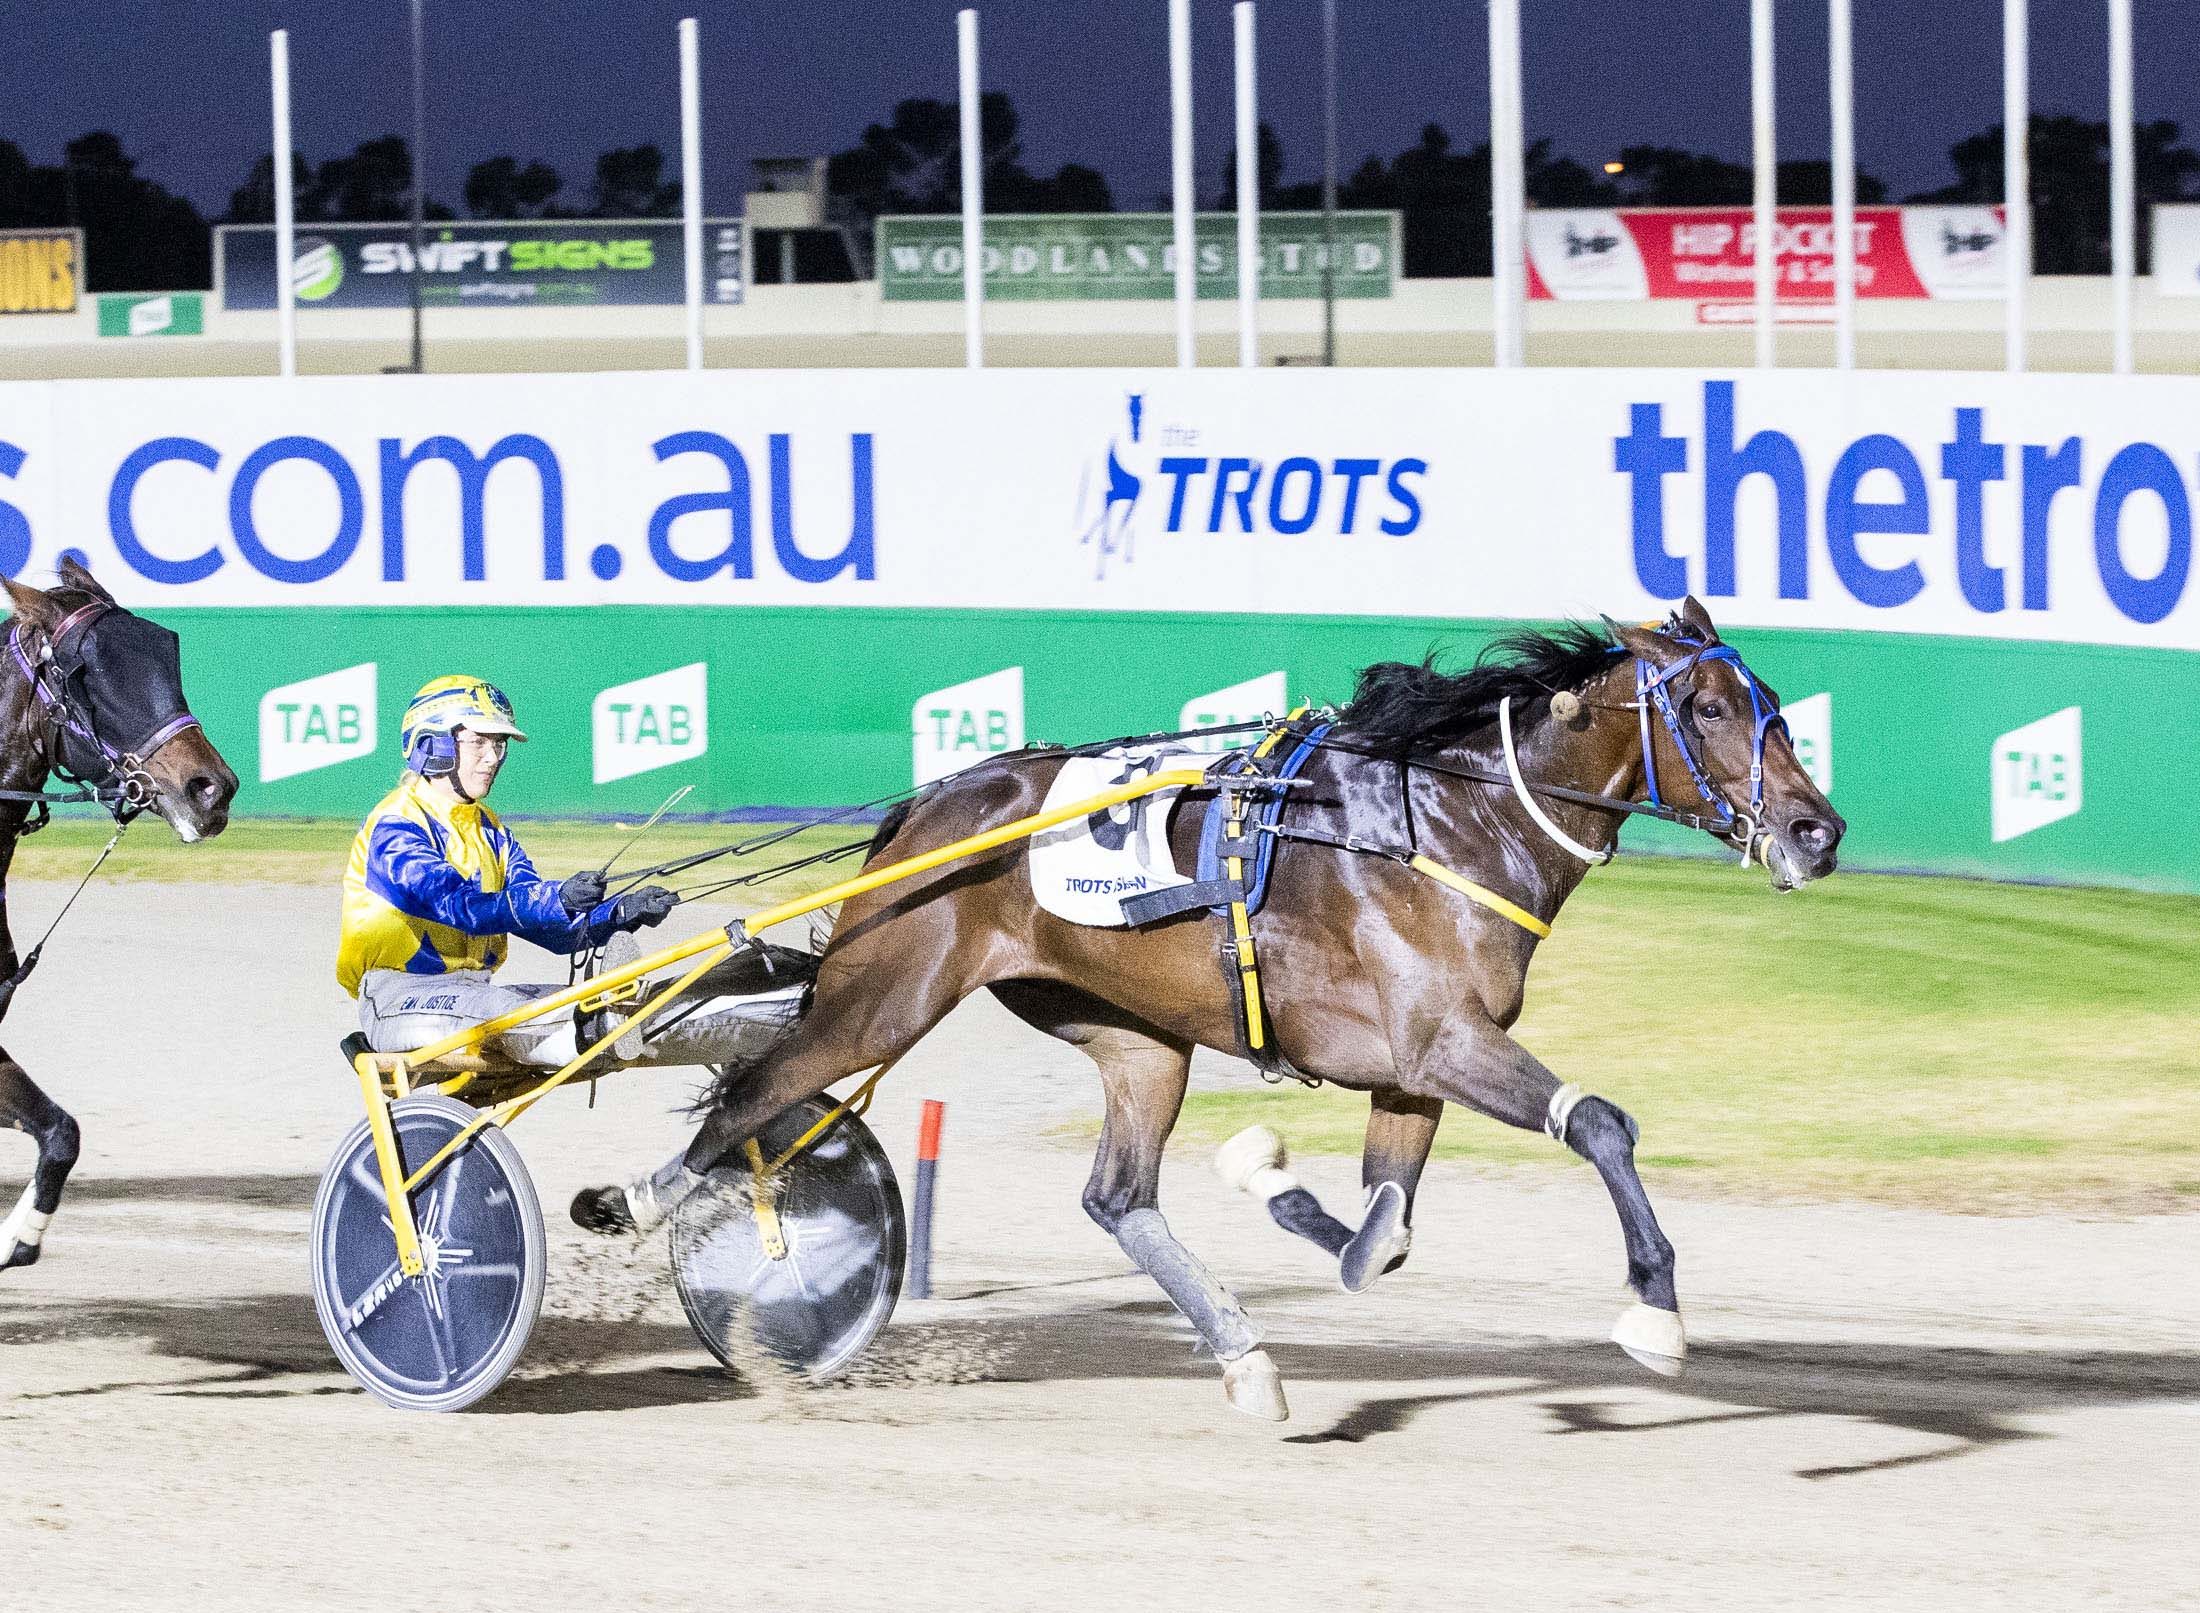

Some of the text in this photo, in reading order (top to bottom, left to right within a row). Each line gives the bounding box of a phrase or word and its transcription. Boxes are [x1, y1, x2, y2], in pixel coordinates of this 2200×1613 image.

[509, 240, 655, 271] SIGNS
[1740, 223, 1878, 255] POCKT
[1159, 456, 1429, 537] TROTS
[1613, 380, 2200, 625] thetro
[276, 702, 361, 745] TAB
[608, 703, 692, 746] TAB
[929, 708, 1010, 752] TAB
[420, 994, 460, 1011] JUSTICE
